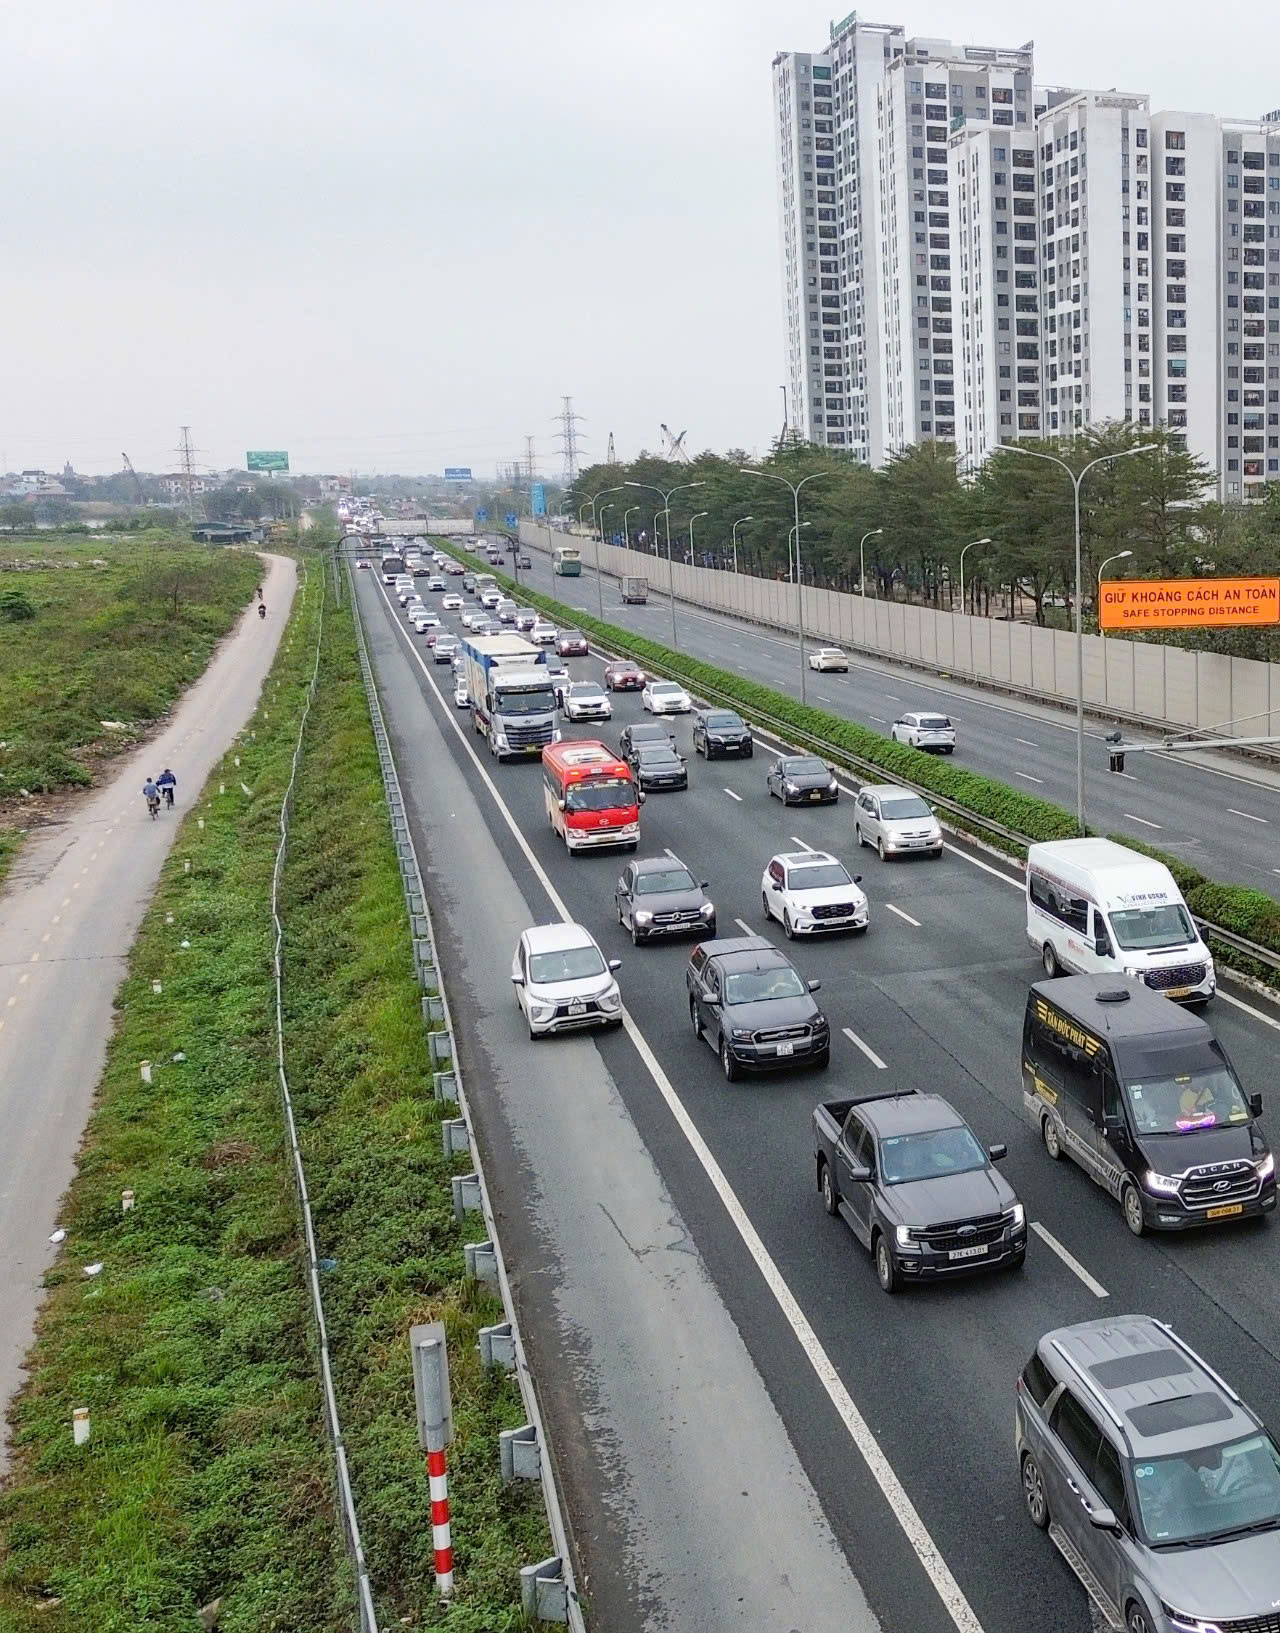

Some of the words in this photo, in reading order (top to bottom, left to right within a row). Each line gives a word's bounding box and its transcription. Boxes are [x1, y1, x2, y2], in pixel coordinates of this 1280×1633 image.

[1104, 588, 1126, 604] GIỮ
[1187, 586, 1219, 602] CÁCH
[1225, 589, 1241, 601] AN
[1246, 585, 1276, 600] TOÀN
[1122, 609, 1150, 618] SAFE
[1153, 607, 1205, 617] STOPPING
[1209, 605, 1259, 615] DISTANCE
[1199, 1162, 1241, 1174] DCAR
